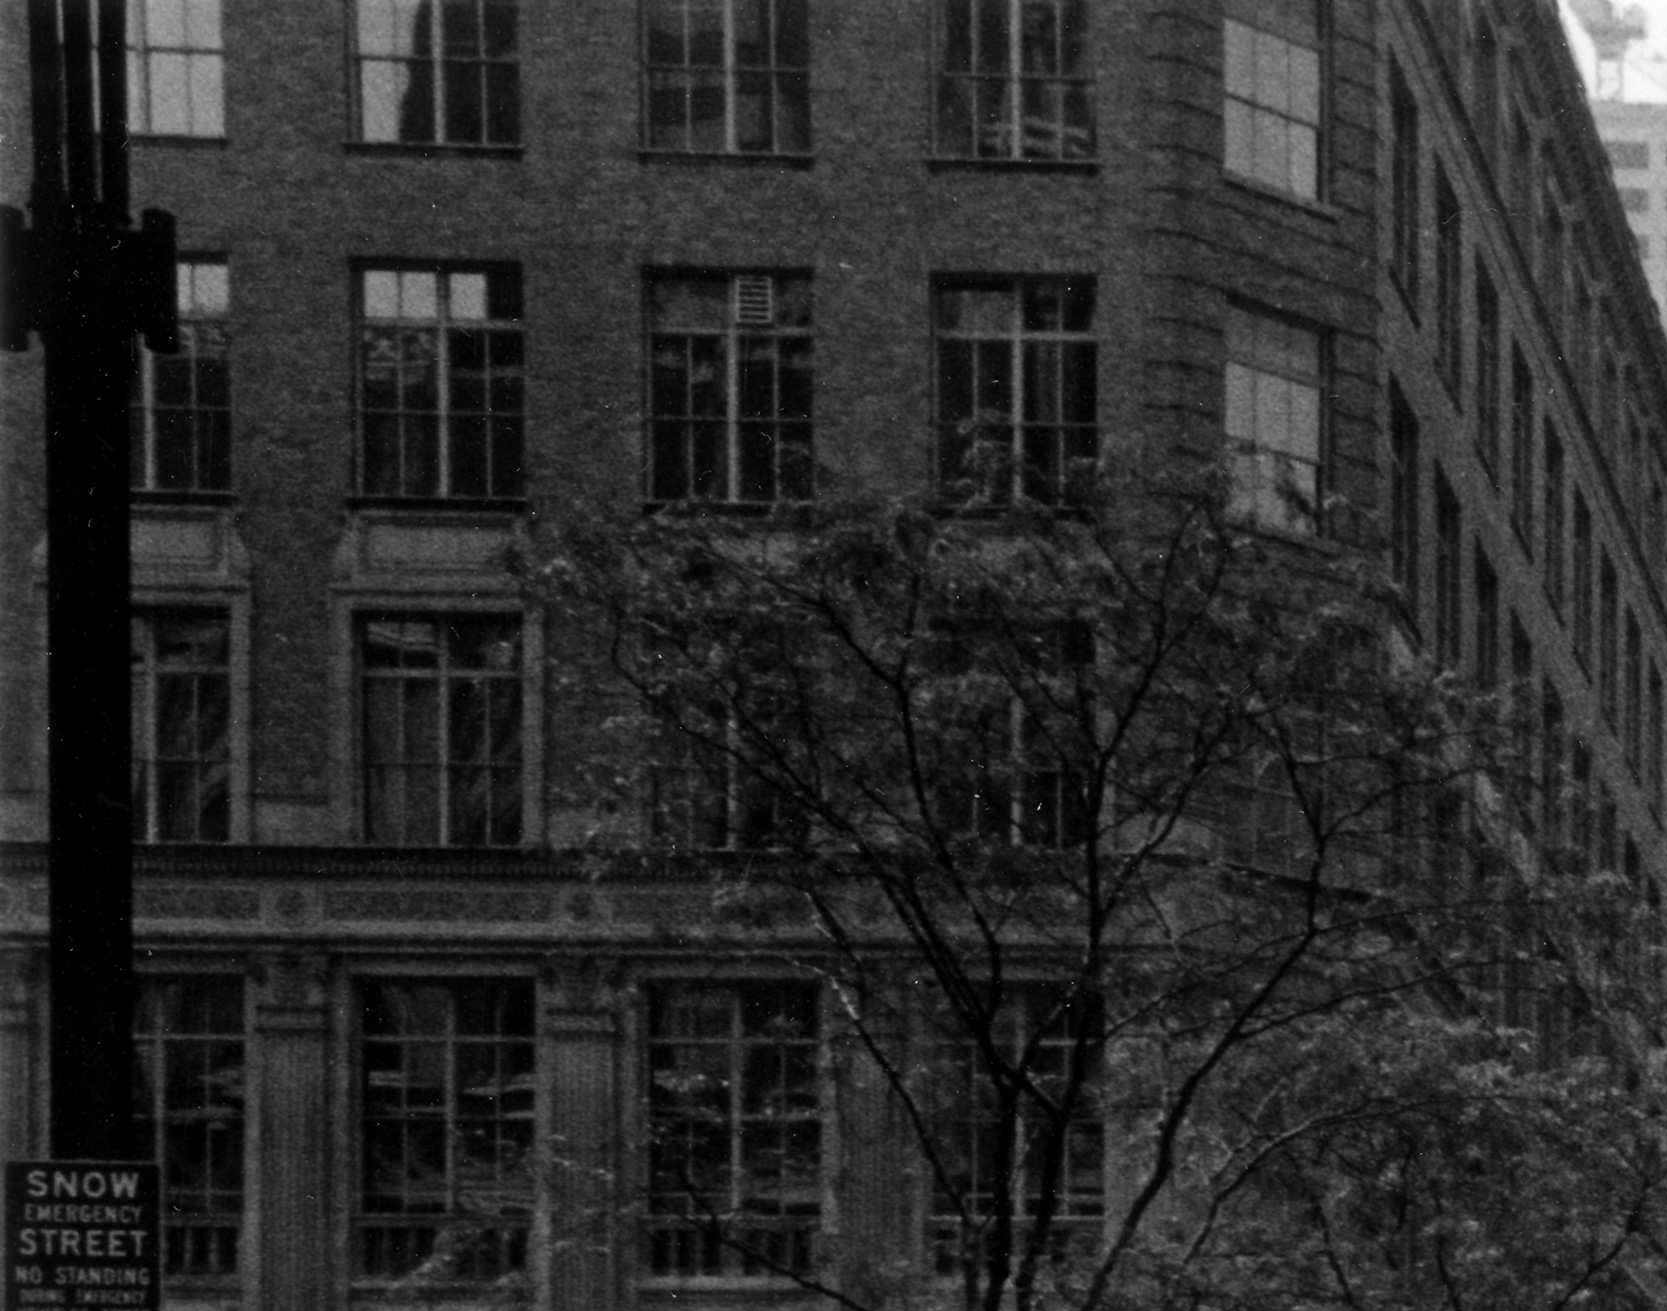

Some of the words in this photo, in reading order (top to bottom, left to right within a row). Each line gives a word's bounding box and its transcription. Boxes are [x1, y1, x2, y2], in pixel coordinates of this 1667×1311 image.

[27, 1170, 139, 1198] SNOW
[24, 1203, 142, 1223] EMERGENCY
[19, 1228, 148, 1256] STREET
[15, 1266, 43, 1284] NO
[54, 1266, 150, 1286] STANDING
